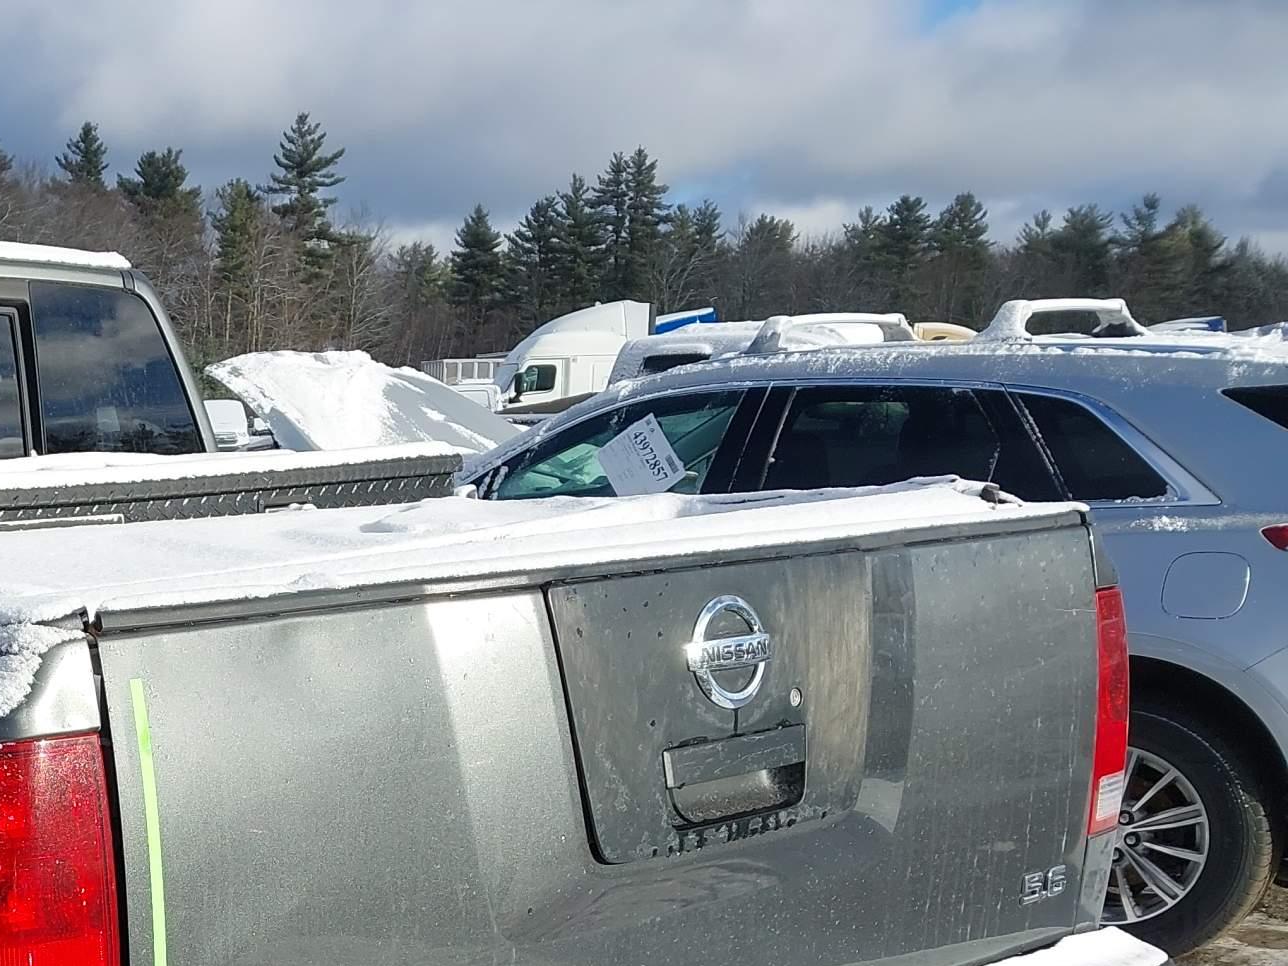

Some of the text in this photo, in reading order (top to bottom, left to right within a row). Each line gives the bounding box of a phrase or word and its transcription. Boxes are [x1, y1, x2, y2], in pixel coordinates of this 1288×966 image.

[632, 430, 669, 482] 43972857
[702, 638, 769, 663] NISSAN
[1018, 864, 1067, 906] 5.6
